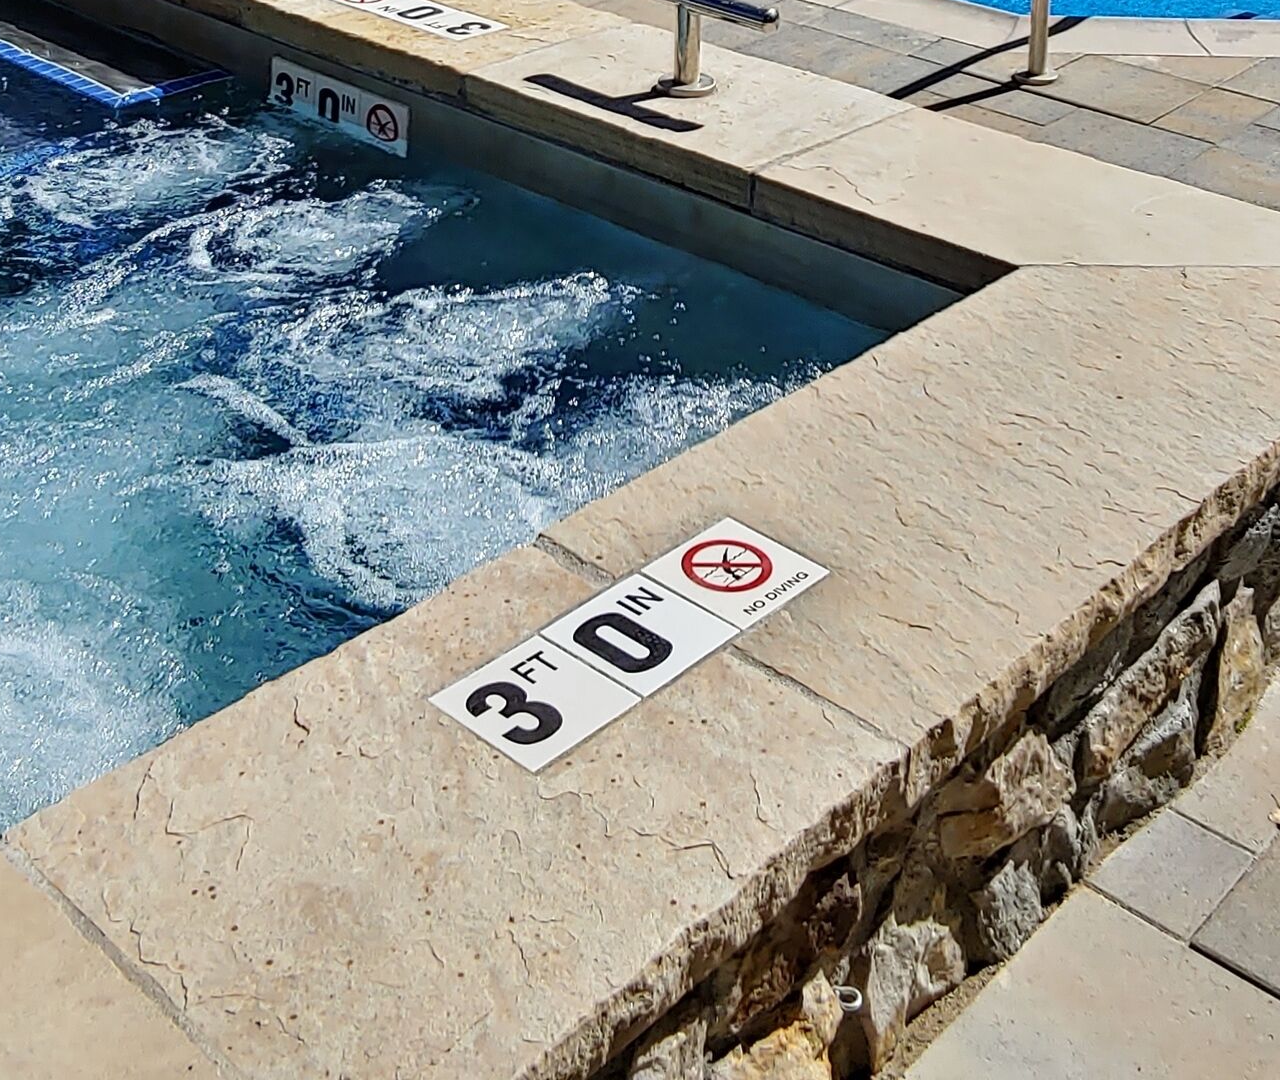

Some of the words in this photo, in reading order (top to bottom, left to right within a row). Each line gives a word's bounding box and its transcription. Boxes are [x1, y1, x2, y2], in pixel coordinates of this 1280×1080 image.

[446, 21, 492, 36] 3
[274, 72, 296, 106] 3
[296, 77, 312, 98] FT
[341, 93, 357, 115] IN
[616, 586, 665, 617] IN
[743, 594, 768, 617] NO
[764, 570, 810, 603] DIVING
[572, 611, 674, 674] 0
[509, 650, 560, 685] FT
[465, 681, 564, 746] 3
